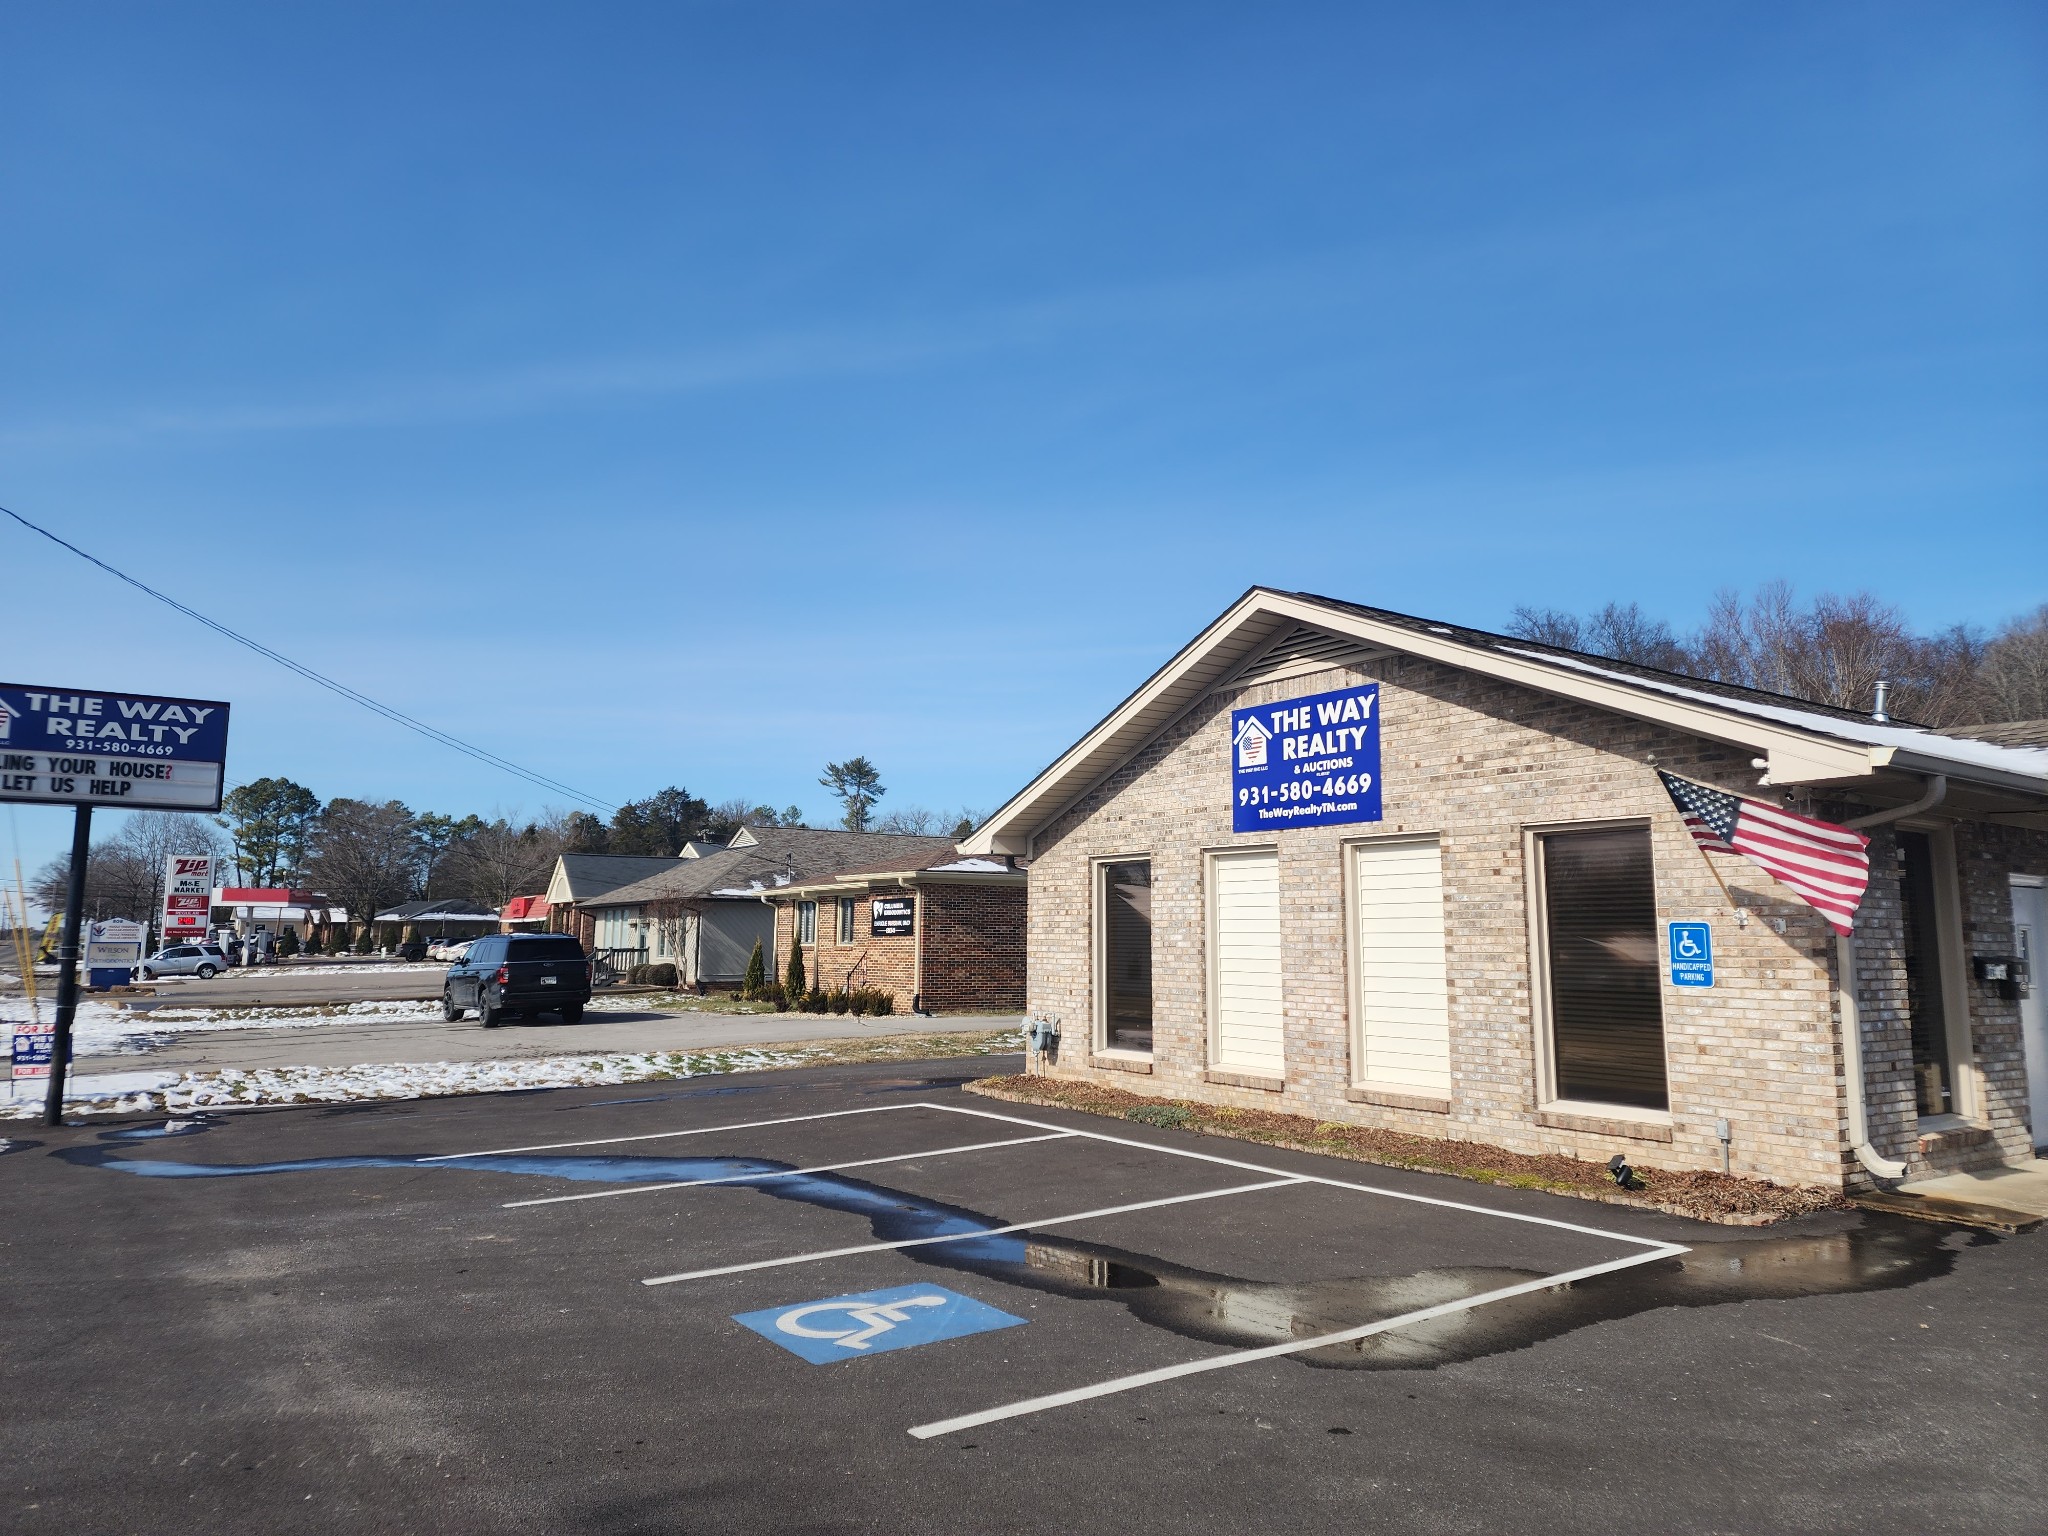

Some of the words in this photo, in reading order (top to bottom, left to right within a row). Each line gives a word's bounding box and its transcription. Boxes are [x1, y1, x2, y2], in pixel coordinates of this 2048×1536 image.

[25, 692, 103, 716] THE
[116, 700, 215, 725] WAY
[1271, 705, 1311, 733] THE
[1316, 693, 1376, 726] WAY
[46, 717, 199, 744] REALTY
[65, 739, 173, 756] 931-580-4669
[1282, 725, 1368, 760] REALTY
[48, 757, 96, 775] YOUR
[109, 761, 173, 779] HOUSE?
[1294, 765, 1301, 774] &
[1302, 757, 1353, 773] AUCTIONS
[2, 775, 37, 791] LET
[51, 777, 75, 793] US
[90, 779, 131, 796] HELP
[1239, 773, 1371, 806] 931-580-4669
[1259, 801, 1357, 819] TheWayRealtyTN.com
[1672, 962, 1711, 971] HANDICAPPED
[1679, 973, 1704, 981] PARKING
[16, 1025, 38, 1035] FOR
